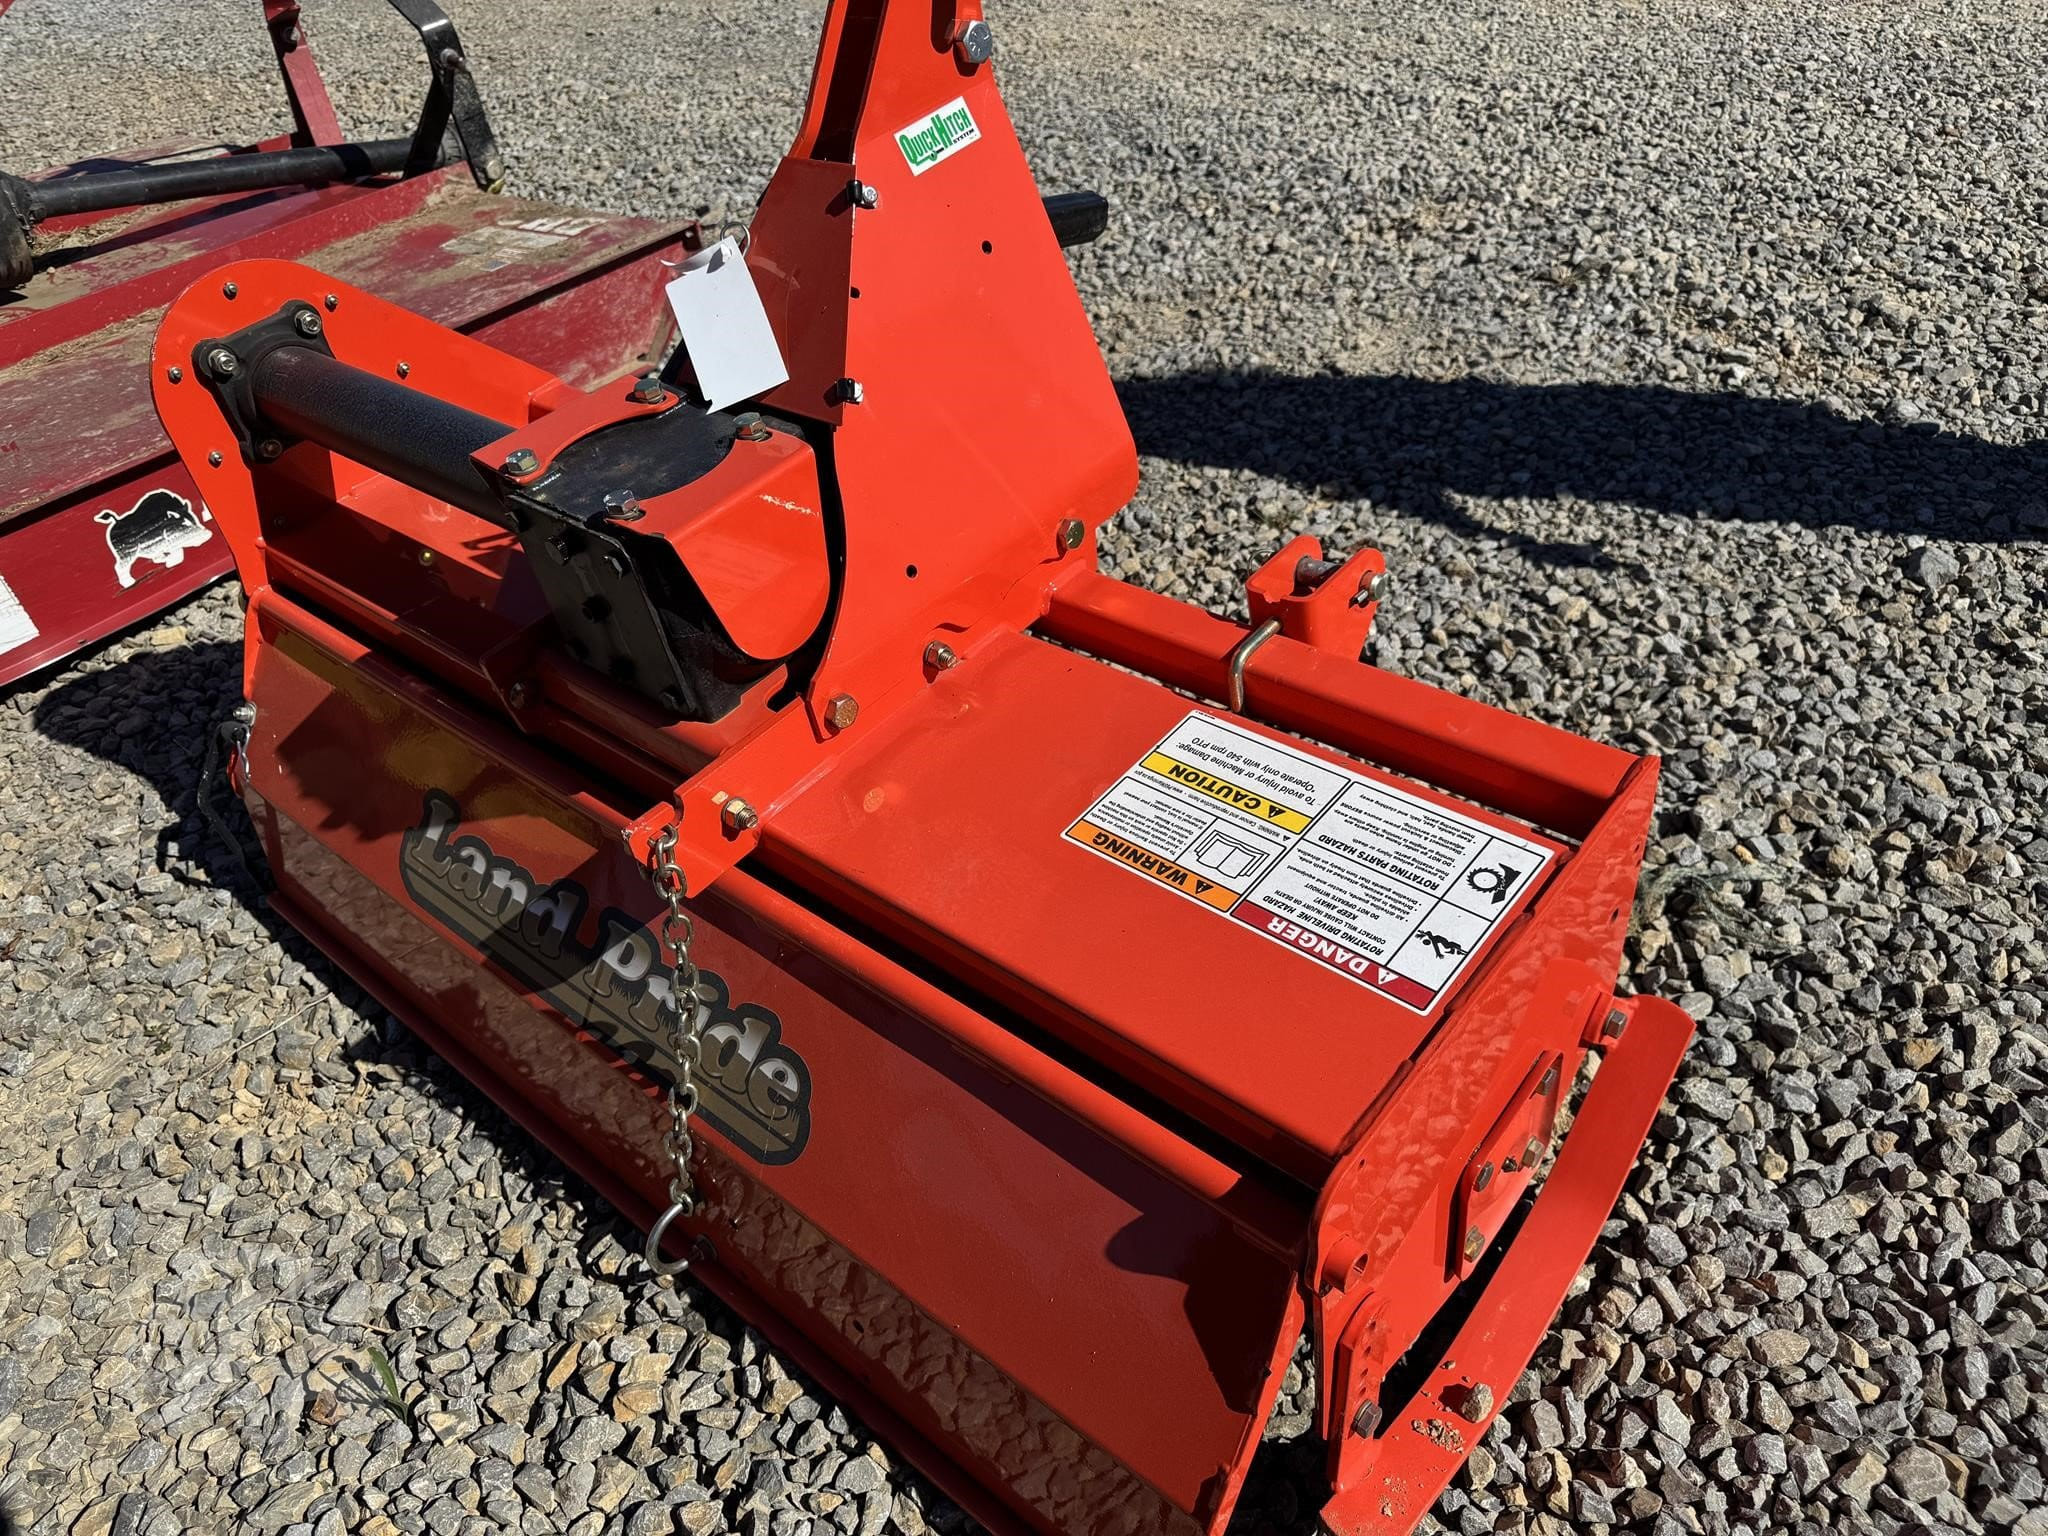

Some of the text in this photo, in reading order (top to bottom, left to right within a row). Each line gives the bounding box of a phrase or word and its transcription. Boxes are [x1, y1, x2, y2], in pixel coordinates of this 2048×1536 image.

[1190, 736, 1211, 748] PTO
[1208, 742, 1229, 755] rpm
[1225, 751, 1243, 761] 540
[1240, 757, 1261, 769] with
[1173, 740, 1317, 805] To avoid Injury or Machine Damage:
[1259, 763, 1282, 777] only
[1166, 763, 1263, 811] CAUTION
[1339, 802, 1363, 813] BEFORE
[1362, 811, 1382, 821] source
[1353, 822, 1369, 831] parts
[1381, 818, 1401, 829] power
[1368, 829, 1384, 838] when
[1399, 827, 1422, 838] lockout
[1351, 838, 1368, 847] death
[1384, 836, 1401, 845] frame
[1428, 838, 1462, 855] Disconnect
[1375, 847, 1393, 857] injury
[1401, 843, 1419, 852] under
[1088, 831, 1190, 885] WARNING
[1317, 833, 1439, 890] ROTATING PARTS HAZARD
[1392, 855, 1414, 867] serious
[1427, 854, 1441, 862] NOT
[1286, 864, 1316, 880] equipment
[1414, 864, 1438, 877] prevent
[410, 798, 581, 960] Land
[1303, 882, 1331, 897] WITHOUT
[1326, 883, 1347, 894] tractor
[1273, 889, 1294, 901] DEATH
[1346, 891, 1369, 904] guards,
[1330, 894, 1357, 909] OPERATE
[1301, 902, 1324, 915] INJURY
[1312, 896, 1358, 920] KEEP AWAY!
[1356, 906, 1370, 915] NOT
[1369, 902, 1395, 916] driveline
[1323, 912, 1344, 924] CAUSE
[1261, 894, 1384, 955] ROTATING DRIVELINE HAZARD
[1342, 921, 1358, 931] WILL
[1357, 928, 1386, 944] CONTACT
[1265, 915, 1371, 974] DANGER
